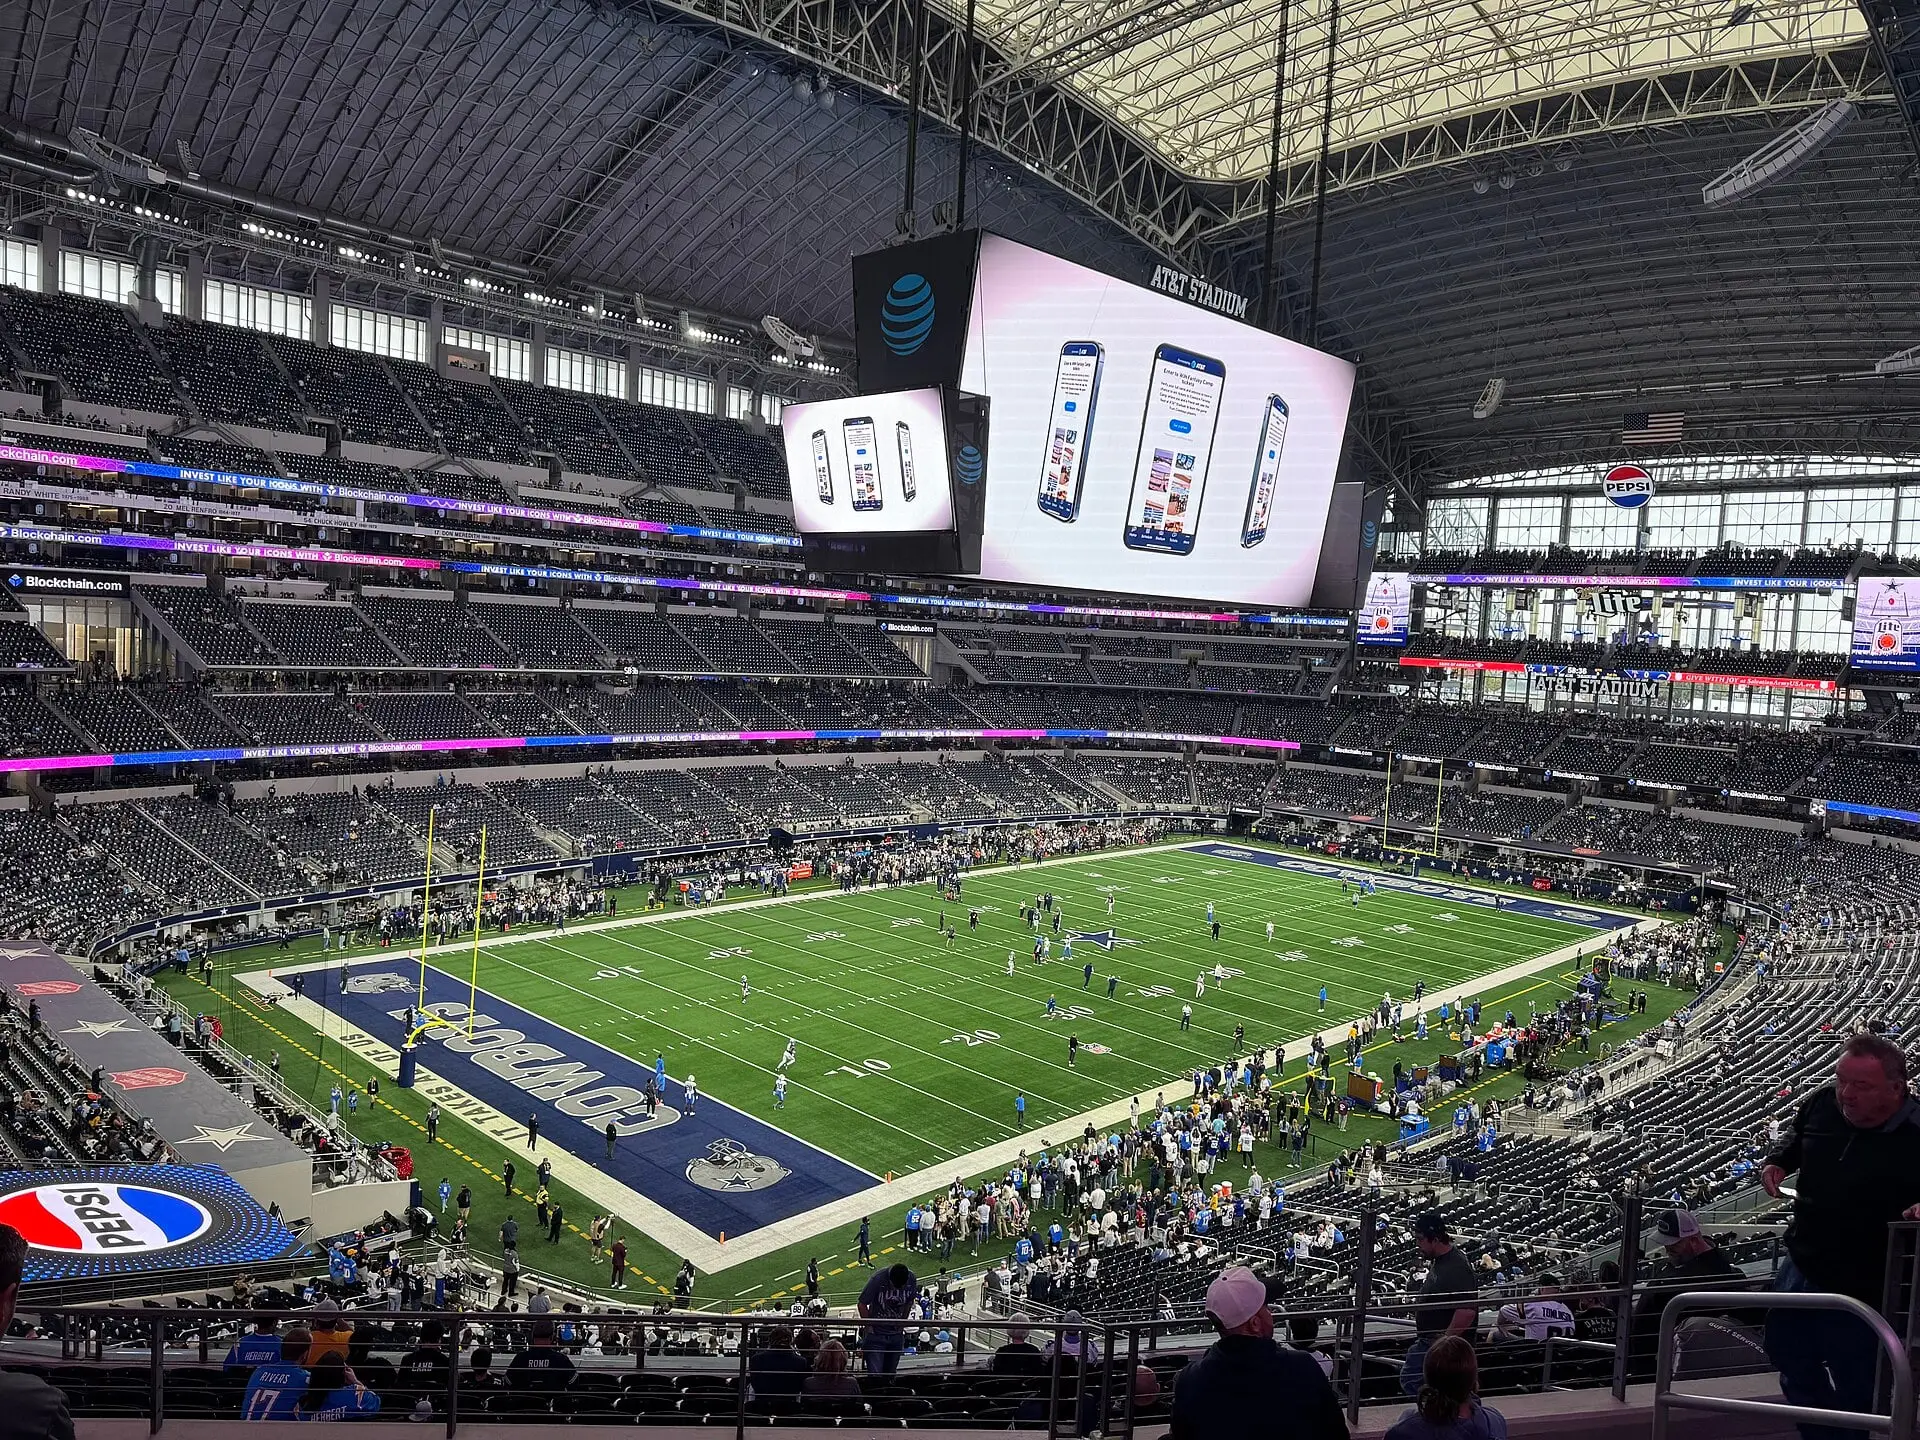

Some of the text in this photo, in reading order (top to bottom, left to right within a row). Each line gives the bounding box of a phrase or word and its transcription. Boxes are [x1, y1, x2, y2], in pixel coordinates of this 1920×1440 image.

[1150, 264, 1248, 319] AT&T STADIUM
[180, 469, 408, 502] INVEST LIKE YOUR ICONS WITH Blockchain.com
[1606, 481, 1651, 492] PEPSI
[3, 488, 60, 500] RANDY WHITE
[191, 506, 218, 514] RENFRO
[458, 501, 639, 529] INVEST LIKE YOUR ICONS WITH Blockchain.com
[314, 518, 358, 528] CHUCK HOWLEY
[11, 528, 102, 545] Blockchain.com
[454, 532, 481, 540] MEREDITH
[700, 529, 721, 537] INVEST
[737, 533, 754, 542] YOUR
[174, 543, 209, 554] INVEST
[211, 545, 231, 554] LIKE
[234, 546, 260, 556] YOUR
[264, 549, 292, 558] ICONS
[295, 551, 319, 560] WITH
[481, 565, 657, 586] INVEST LIKE YOUR ICONS WITH Blockchain.com
[1486, 575, 1659, 585] INVEST LIKE YOUR ICONS WITH Blockchain.com
[26, 575, 122, 592] Blockchain.com
[700, 582, 721, 591] INVEST
[722, 584, 735, 592] LIKE
[737, 585, 754, 593] YOUR
[755, 586, 774, 595] ICONS
[1734, 579, 1762, 587] INVEST
[1765, 579, 1781, 587] LIKE
[1785, 579, 1808, 588] YOUR
[930, 598, 944, 606] YOUR
[946, 599, 962, 607] ICONS
[1591, 591, 1643, 618] Lite
[1065, 606, 1086, 614] INVEST
[1086, 607, 1099, 615] LIKE
[1100, 608, 1114, 616] YOUR
[1116, 609, 1134, 617] ICONS
[1375, 607, 1391, 616] Lite
[888, 623, 934, 633] Blockchain.com
[1294, 617, 1307, 625] LIKE
[1328, 618, 1348, 627] ICONS
[1878, 622, 1900, 633] Lite
[1535, 676, 1658, 698] AT&T STADIUM
[243, 749, 270, 758] INVEST
[272, 748, 288, 757] LIKE
[289, 747, 311, 756] YOUR
[312, 746, 335, 755] ICONS
[368, 743, 422, 752] Blockchain.com
[1335, 747, 1372, 756] Blockchain.com
[1475, 762, 1519, 773] Blockchain.com
[1552, 770, 1600, 781] Blockchain.com
[1636, 779, 1687, 791] Blockchain.com
[1729, 789, 1786, 802] Blockchain.com
[709, 946, 753, 959] 20
[596, 965, 645, 979] 10
[1137, 984, 1176, 997] 40
[951, 1028, 1002, 1047] 20
[339, 1033, 399, 1063] OF US
[387, 1002, 682, 1137] COWBOYS
[837, 1058, 892, 1079] 10
[425, 1085, 529, 1141] IT TAKES
[57, 1188, 147, 1248] PEPSI
[1021, 1247, 1029, 1255] 10
[1295, 1241, 1301, 1249] 8
[793, 1305, 802, 1313] 89
[1541, 1307, 1572, 1322] TOMLINSO
[1731, 1331, 1764, 1354] SERVICES
[245, 1351, 274, 1361] HERBERT
[528, 1359, 550, 1368] ROMO
[260, 1371, 290, 1384] RIVERS
[247, 1388, 282, 1421] 17
[310, 1405, 347, 1423] HERBERT
